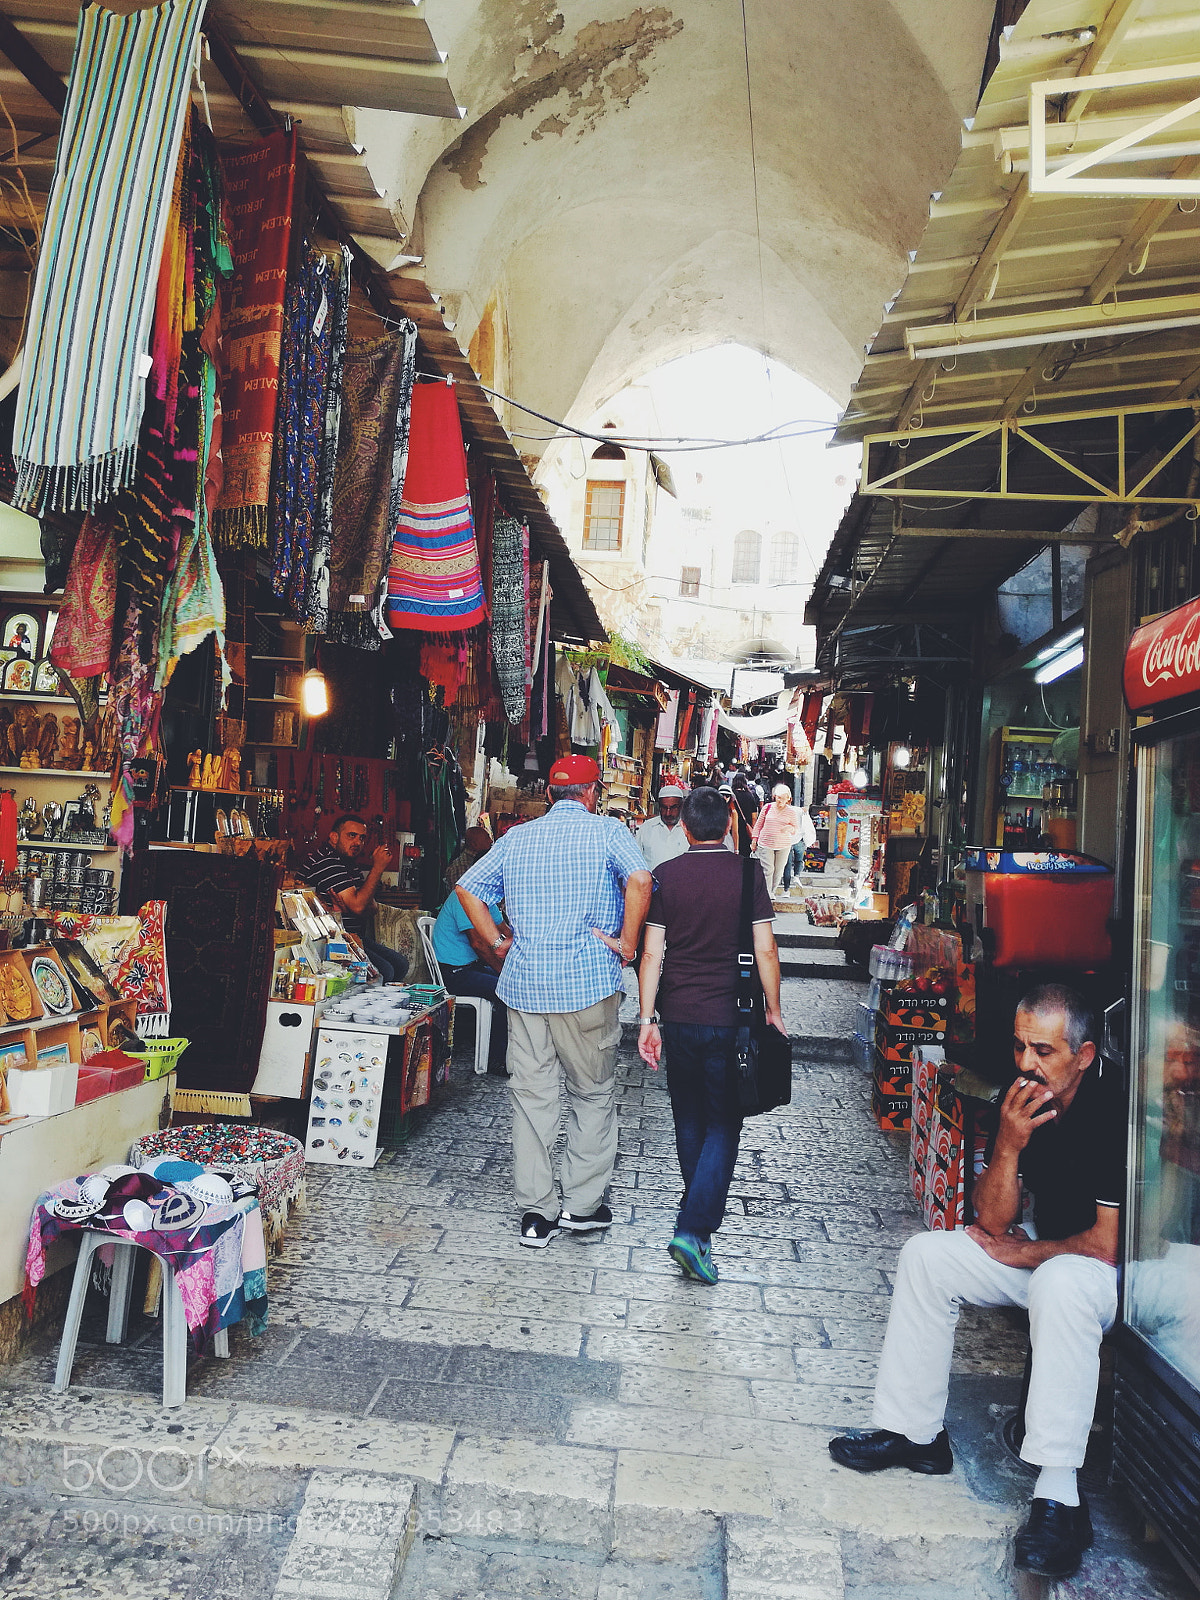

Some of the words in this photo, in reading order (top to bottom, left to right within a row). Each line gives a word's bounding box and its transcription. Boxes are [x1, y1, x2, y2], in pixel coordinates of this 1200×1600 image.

[898, 999, 918, 1007] הדר
[920, 999, 937, 1007] פרי
[895, 1032, 915, 1041] הדר
[918, 1032, 934, 1040] פרי
[889, 1066, 910, 1075] הדר
[888, 1101, 908, 1110] הדר
